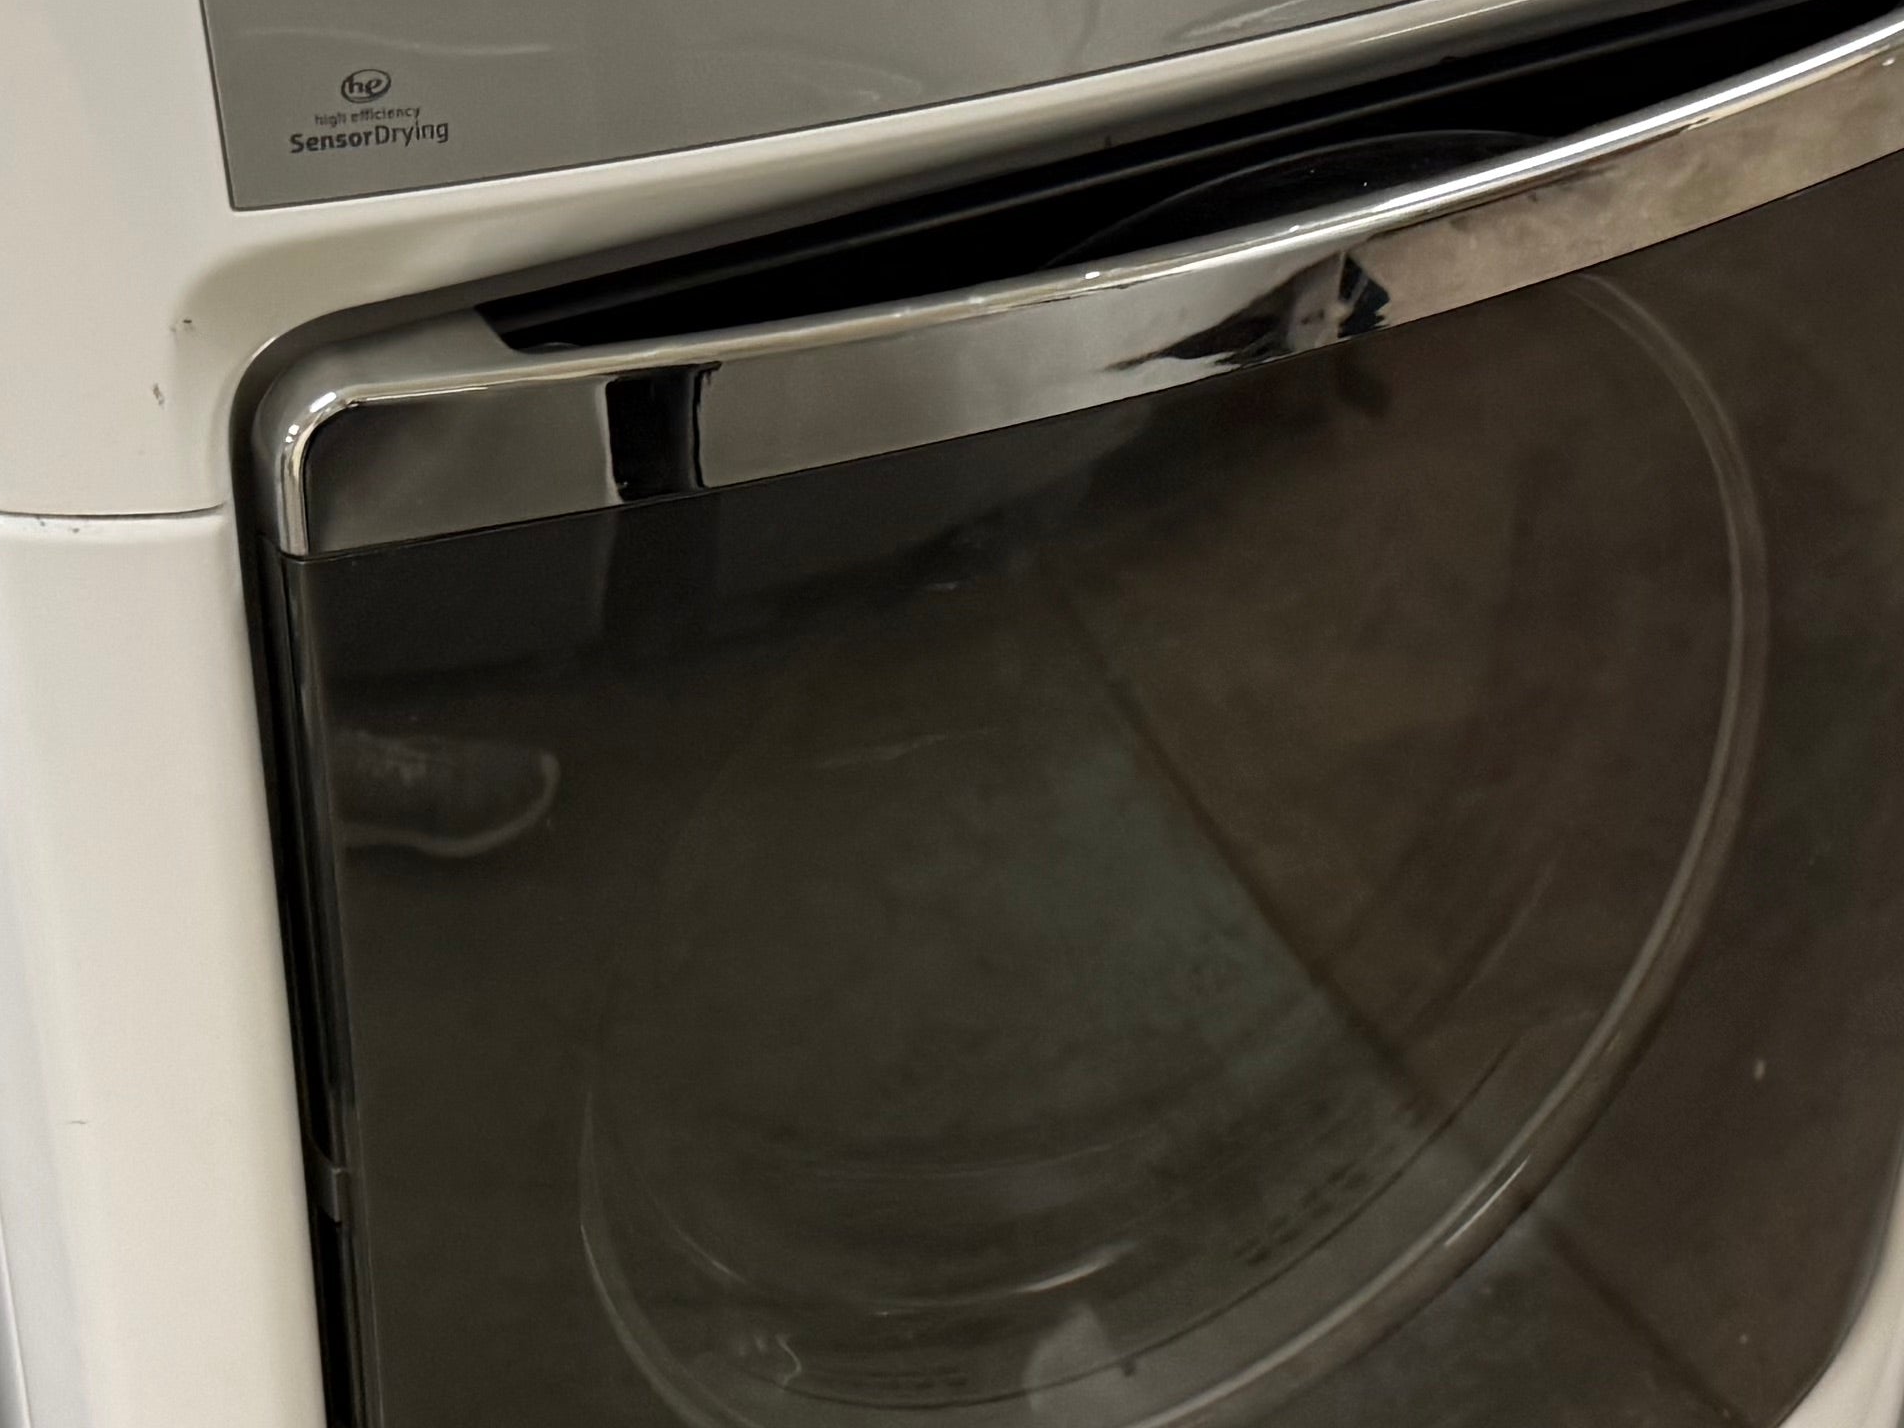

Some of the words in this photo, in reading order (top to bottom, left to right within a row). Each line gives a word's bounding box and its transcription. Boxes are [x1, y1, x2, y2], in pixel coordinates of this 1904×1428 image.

[314, 109, 348, 129] high
[350, 104, 422, 125] efficiency
[289, 119, 450, 156] SensorDrying
